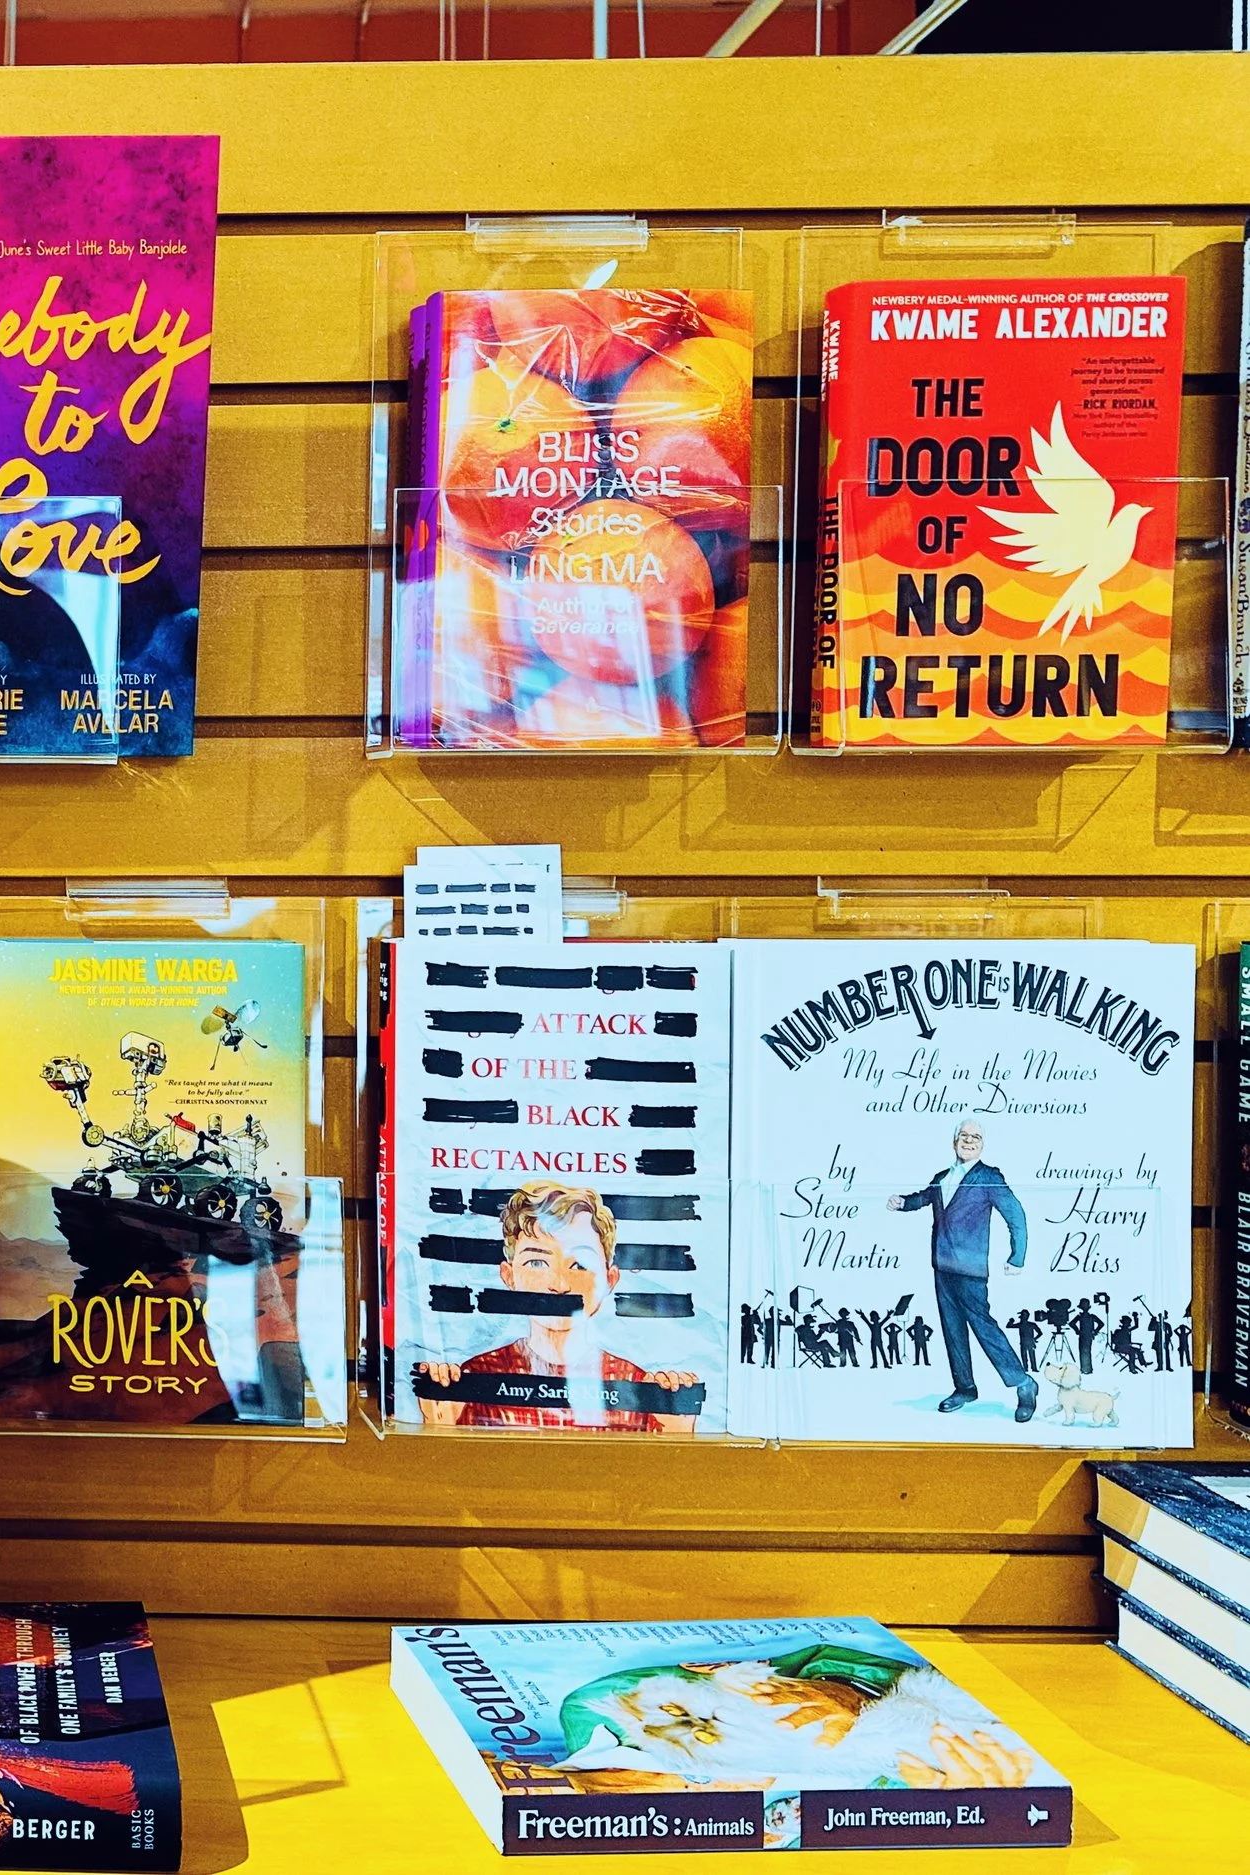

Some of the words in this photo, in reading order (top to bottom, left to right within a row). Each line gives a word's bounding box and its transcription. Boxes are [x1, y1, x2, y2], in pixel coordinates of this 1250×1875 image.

[36, 239, 71, 256] Sweet
[76, 239, 103, 256] Little
[108, 239, 135, 260] Baby
[139, 239, 187, 260] Banjolele
[872, 295, 925, 306] NEWBERY
[927, 294, 1018, 305] MEDAL-WINNING
[1020, 294, 1066, 304] AUTHOR
[1068, 293, 1084, 303] OF
[1086, 292, 1106, 302] THE
[1108, 291, 1170, 302] CROSSOVER
[870, 308, 979, 341] KWAME
[995, 306, 1168, 340] ALEXANDER
[828, 320, 841, 382] KWAME
[19, 370, 110, 455] to
[911, 378, 985, 418] THE
[538, 430, 639, 463] BLISS
[493, 465, 681, 498] MONTAGE
[867, 436, 1021, 498] DOOR
[529, 506, 643, 537] Stories
[917, 515, 967, 554] OF
[510, 553, 593, 584] LING
[600, 553, 664, 584] MA
[895, 572, 984, 637] NO
[859, 653, 1119, 719] RETURN
[49, 957, 147, 983] JASMINE
[155, 957, 238, 983] WARGA
[530, 1012, 647, 1035] ATTACK
[760, 963, 936, 1071] NUMBER
[924, 958, 1001, 1010] ONE
[1012, 961, 1180, 1076] WALKING
[471, 1057, 509, 1078] OF
[517, 1057, 577, 1080] THE
[843, 1047, 884, 1087] My
[892, 1047, 942, 1088] Life
[952, 1061, 971, 1081] in
[982, 1053, 1011, 1081] the
[1024, 1048, 1098, 1082] Movies
[527, 1104, 620, 1127] BLACK
[865, 1087, 906, 1114] and
[913, 1086, 969, 1114] Other
[972, 1081, 1088, 1115] Diversions
[430, 1147, 627, 1174] RECTANGLES
[827, 1144, 857, 1191] by
[1036, 1152, 1123, 1190] drawings
[1137, 1153, 1158, 1189] by
[780, 1177, 859, 1220] Steve
[1045, 1183, 1147, 1236] Harry
[803, 1227, 901, 1271] Martin
[1050, 1232, 1121, 1274] Bliss
[69, 1375, 208, 1395] STORY
[404, 1627, 575, 1791] Freeman's
[12, 1818, 96, 1841] BERGER
[131, 1809, 142, 1849] BASIC
[144, 1808, 155, 1850] BOOKS
[685, 1819, 755, 1837] Animals
[823, 1807, 866, 1832] John
[870, 1806, 952, 1829] Freeman,
[957, 1805, 986, 1825] Ed.
